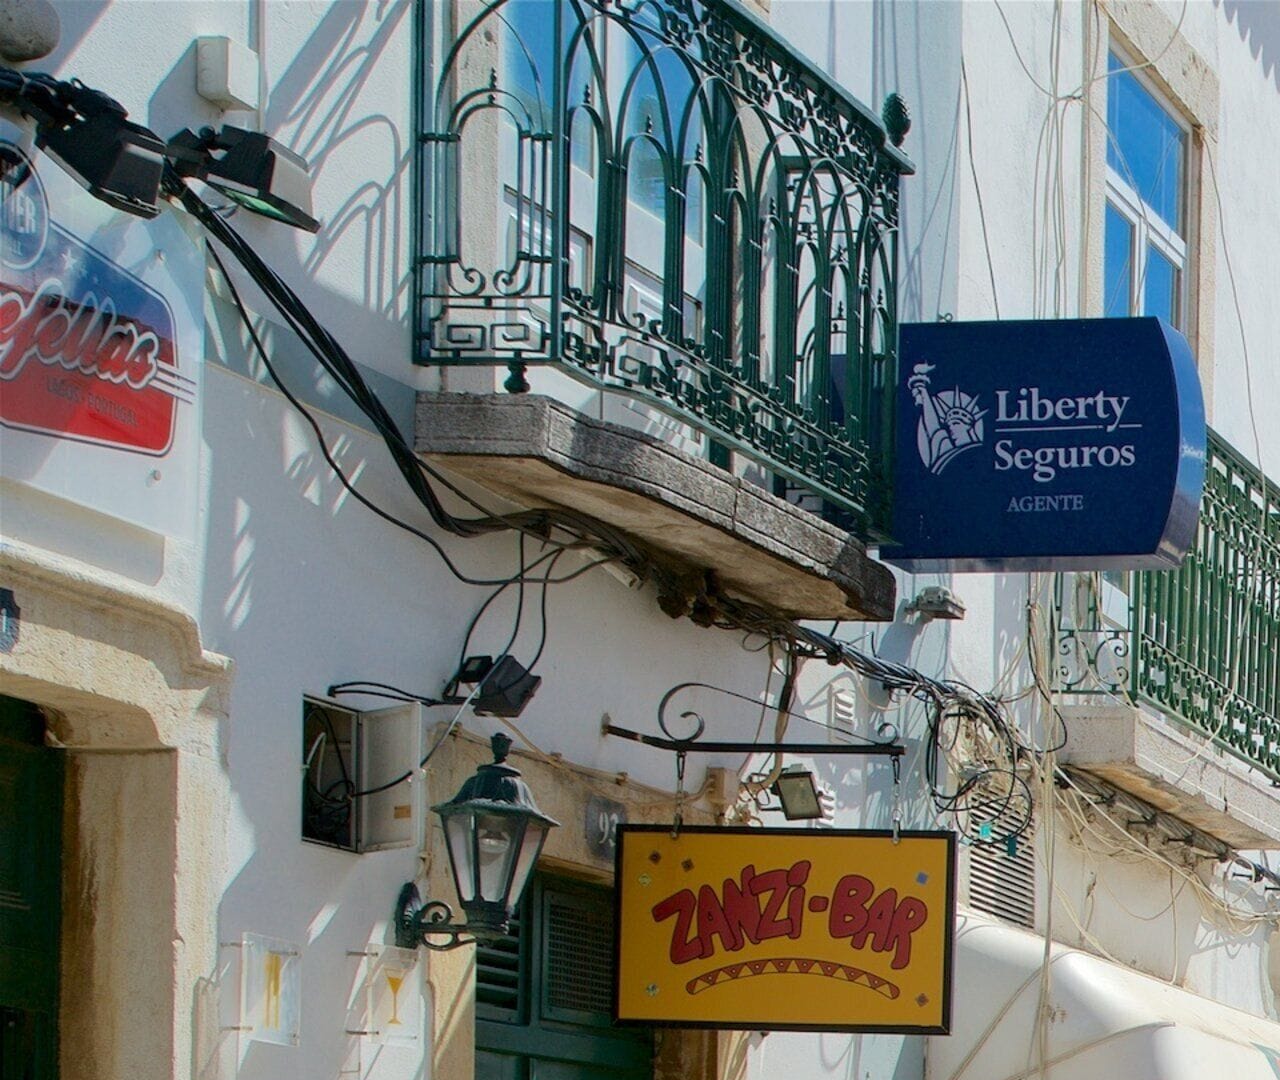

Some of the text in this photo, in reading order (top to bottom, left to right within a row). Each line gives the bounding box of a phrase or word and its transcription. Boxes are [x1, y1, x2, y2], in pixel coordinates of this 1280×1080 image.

[995, 387, 1131, 432] Liberty
[994, 440, 1136, 483] Seguros
[1006, 495, 1084, 513] AGENTE
